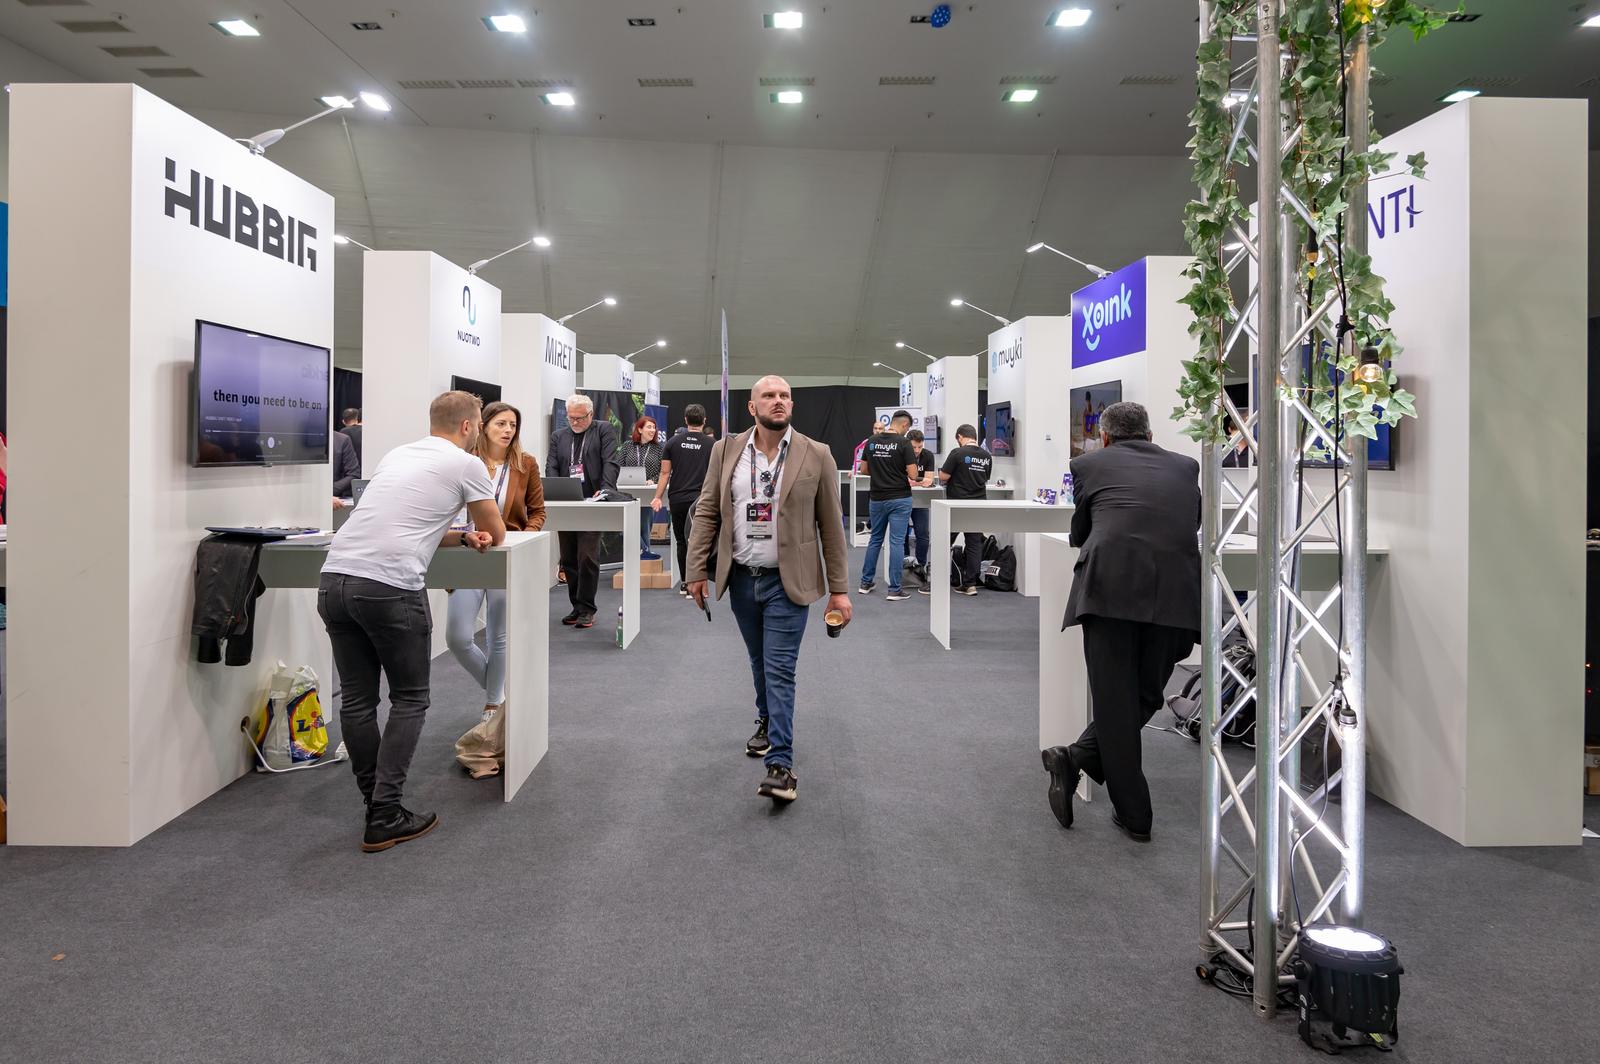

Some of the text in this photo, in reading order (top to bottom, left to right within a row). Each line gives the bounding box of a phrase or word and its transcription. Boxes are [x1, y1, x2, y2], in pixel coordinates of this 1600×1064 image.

[165, 157, 317, 273] HUBBIG
[1367, 184, 1424, 239] NTI
[457, 329, 481, 347] NUOTWO
[545, 335, 573, 371] MIRET
[998, 336, 1023, 368] muyki
[213, 389, 322, 411] then you need to be on
[681, 442, 702, 450] CREW
[874, 443, 898, 452] muyki
